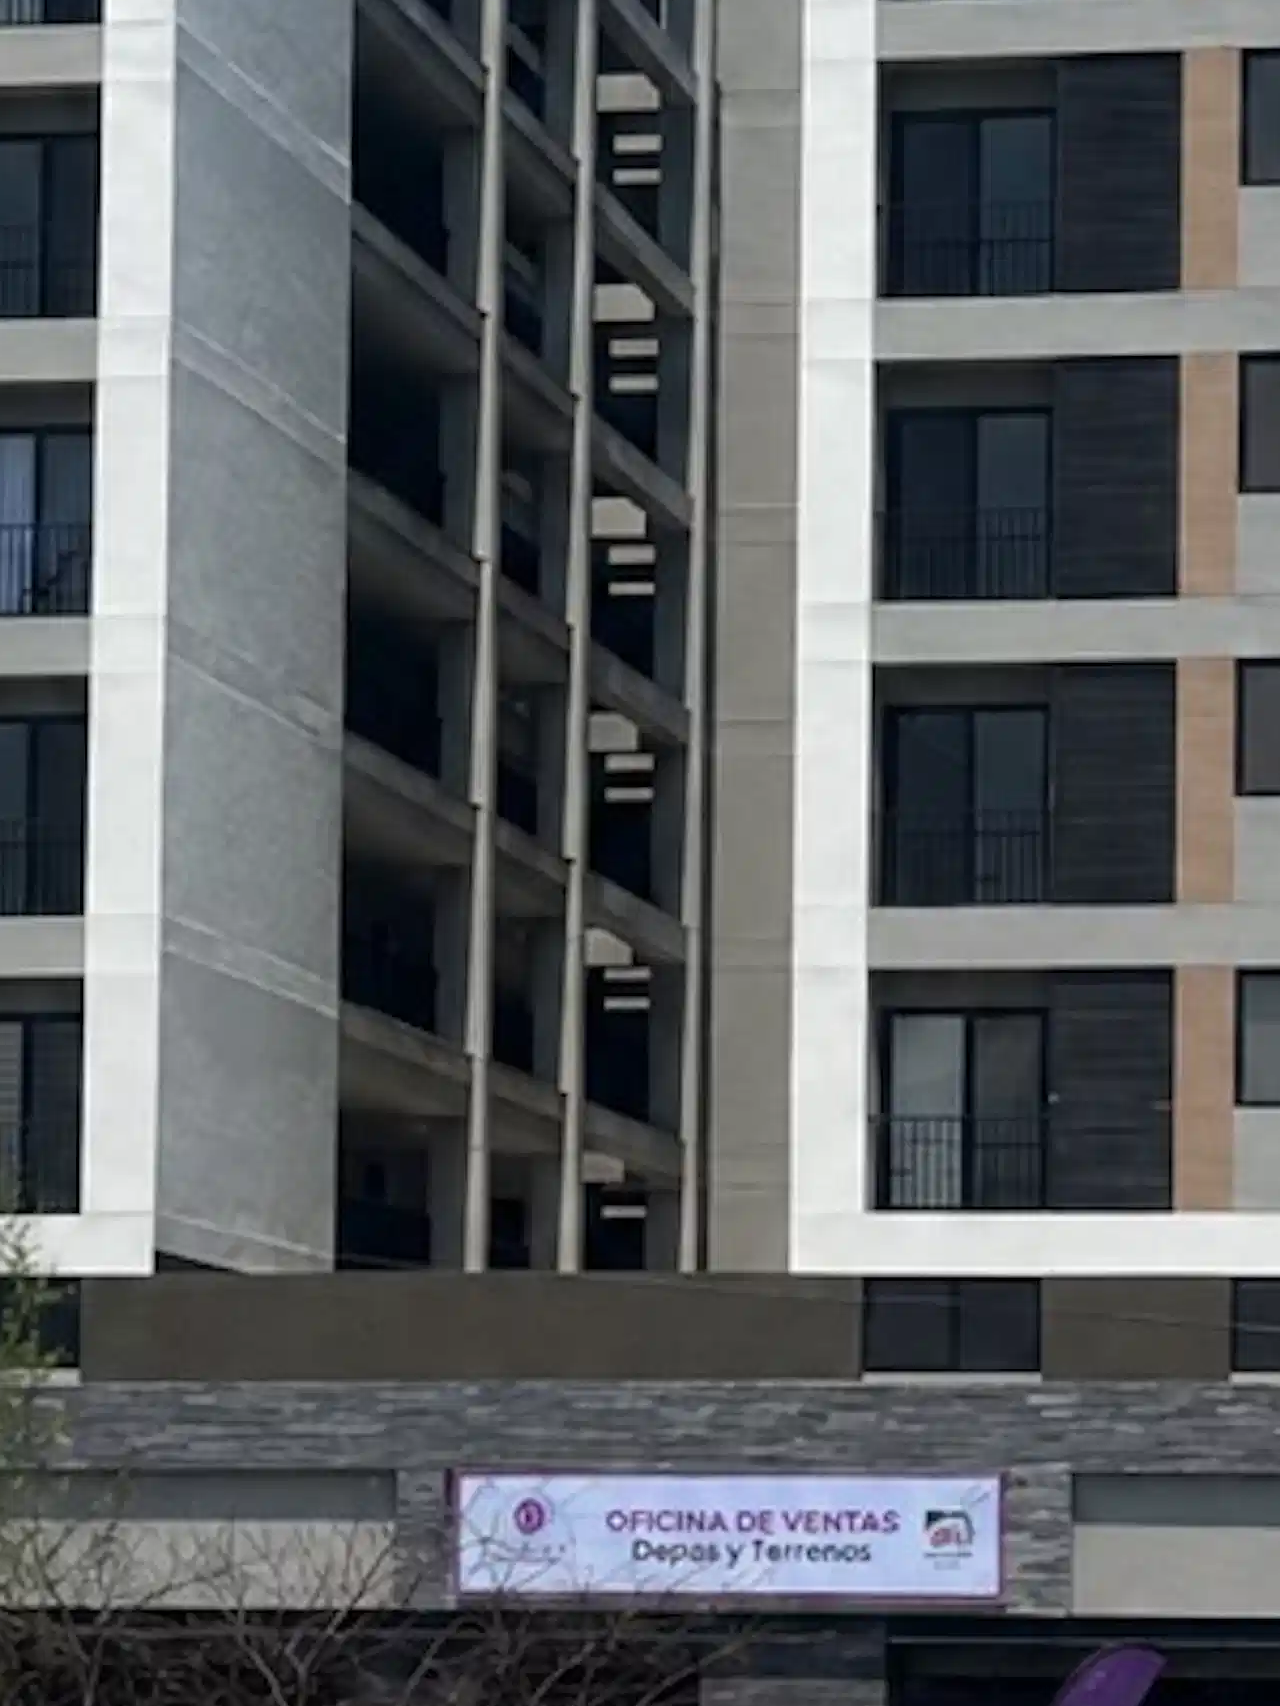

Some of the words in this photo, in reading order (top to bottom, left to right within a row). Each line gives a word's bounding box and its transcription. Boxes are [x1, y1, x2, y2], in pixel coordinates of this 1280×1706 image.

[605, 1509, 727, 1533] OFICINA
[736, 1509, 775, 1534] DE
[783, 1509, 901, 1534] VENTAS
[631, 1539, 720, 1568] Depas
[726, 1542, 747, 1568] y
[751, 1539, 872, 1562] Terrenos
